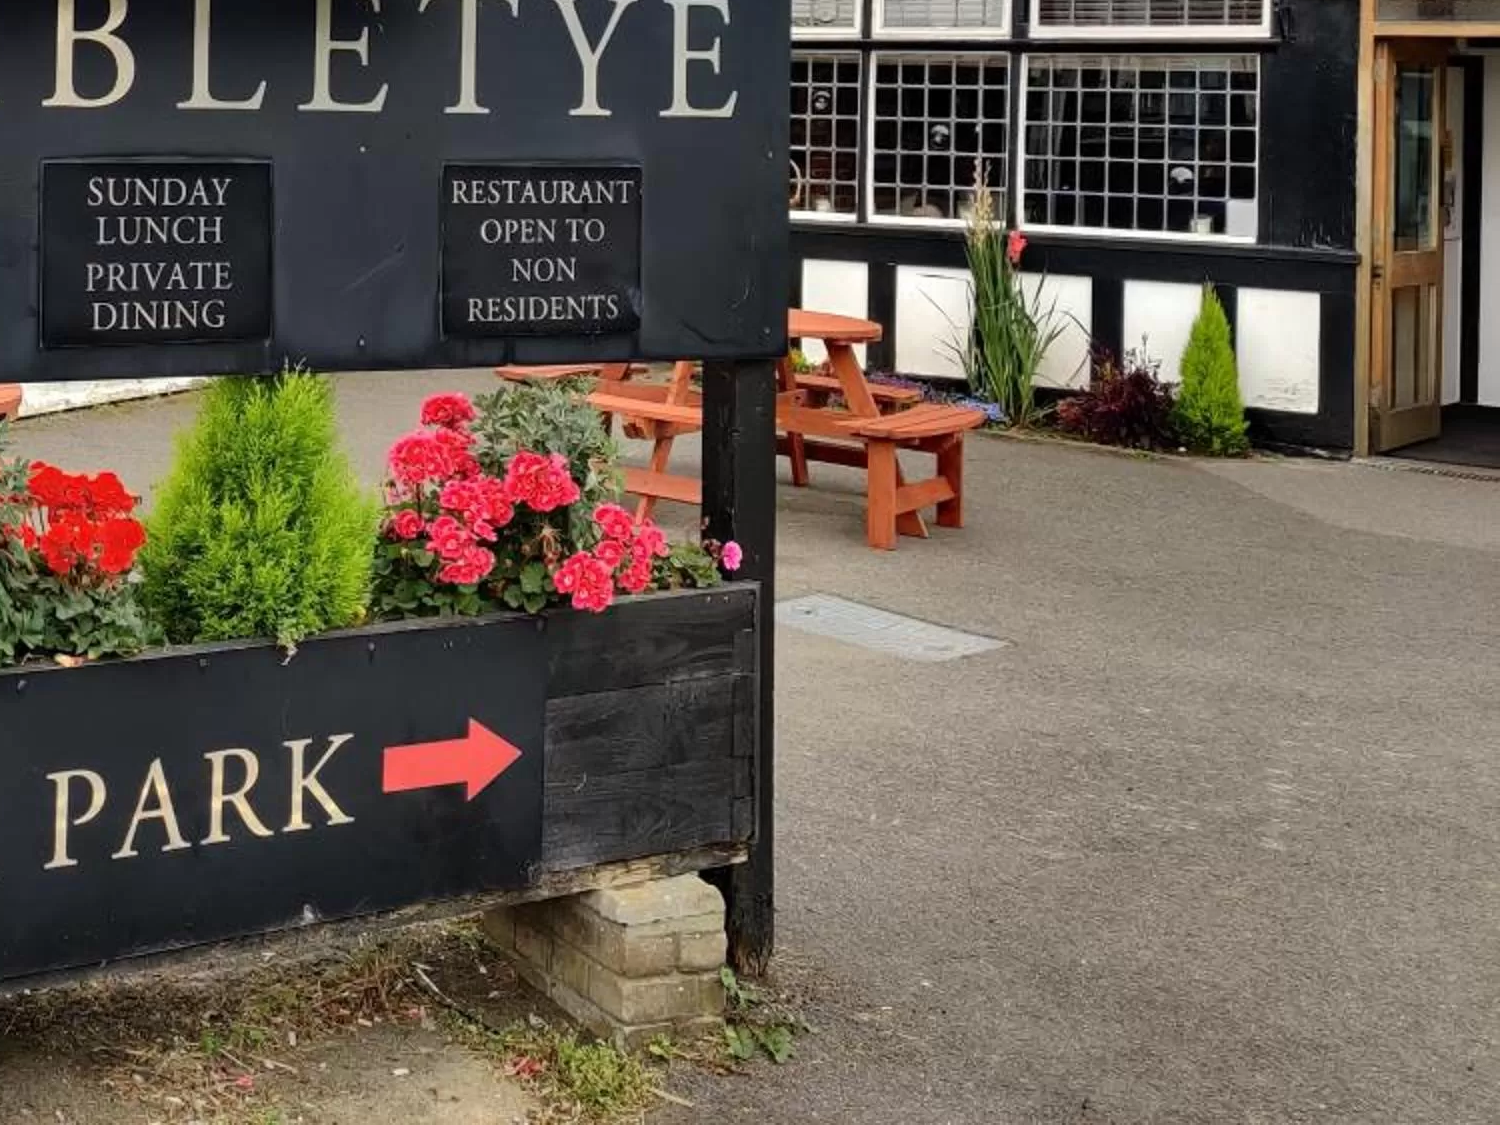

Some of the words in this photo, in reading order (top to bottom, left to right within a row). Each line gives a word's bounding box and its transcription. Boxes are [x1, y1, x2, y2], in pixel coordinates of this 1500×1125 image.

[87, 176, 232, 207] SUNDAY
[451, 179, 635, 205] RESTAURANT
[96, 216, 223, 245] LUNCH
[479, 218, 558, 245] OPEN
[565, 218, 606, 243] TO
[85, 261, 233, 292] PRIVATE
[511, 257, 577, 283] NON
[92, 299, 226, 331] DINING
[467, 294, 620, 323] RESIDENTS
[43, 733, 355, 871] PARK
